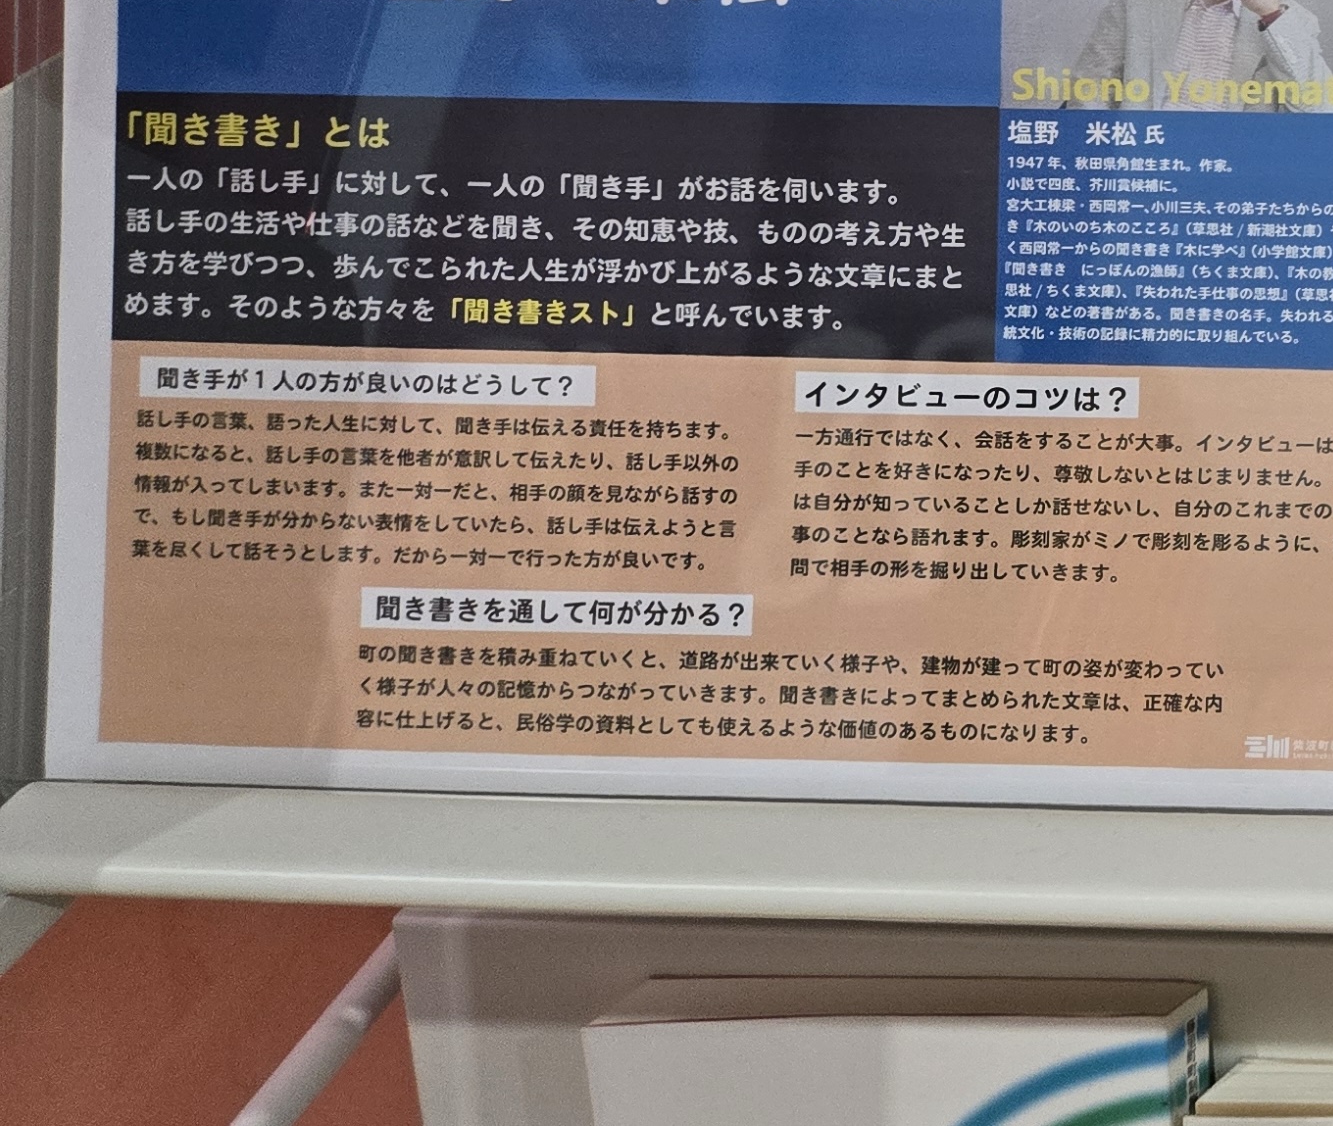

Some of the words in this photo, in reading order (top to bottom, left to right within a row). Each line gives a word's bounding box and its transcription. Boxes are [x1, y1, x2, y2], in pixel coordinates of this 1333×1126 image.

[1012, 67, 1151, 104] Shiono
[1008, 121, 1059, 145] 塩野
[1086, 122, 1137, 146] 米松
[1144, 124, 1165, 145] 氏
[127, 208, 966, 248] 話し手の生活や仕事の話などを聞き、その知恵や技、ものの考え方や生
[127, 250, 963, 291] き方を学びつつ、歩んでこられた人生が浮かび上がるような文章にまと
[805, 381, 1127, 413] インタビューのコツは？
[790, 558, 1120, 583] 問で相手の形を掘り出していきます。
[376, 595, 745, 627] 聞き書きを通して何が分かる？
